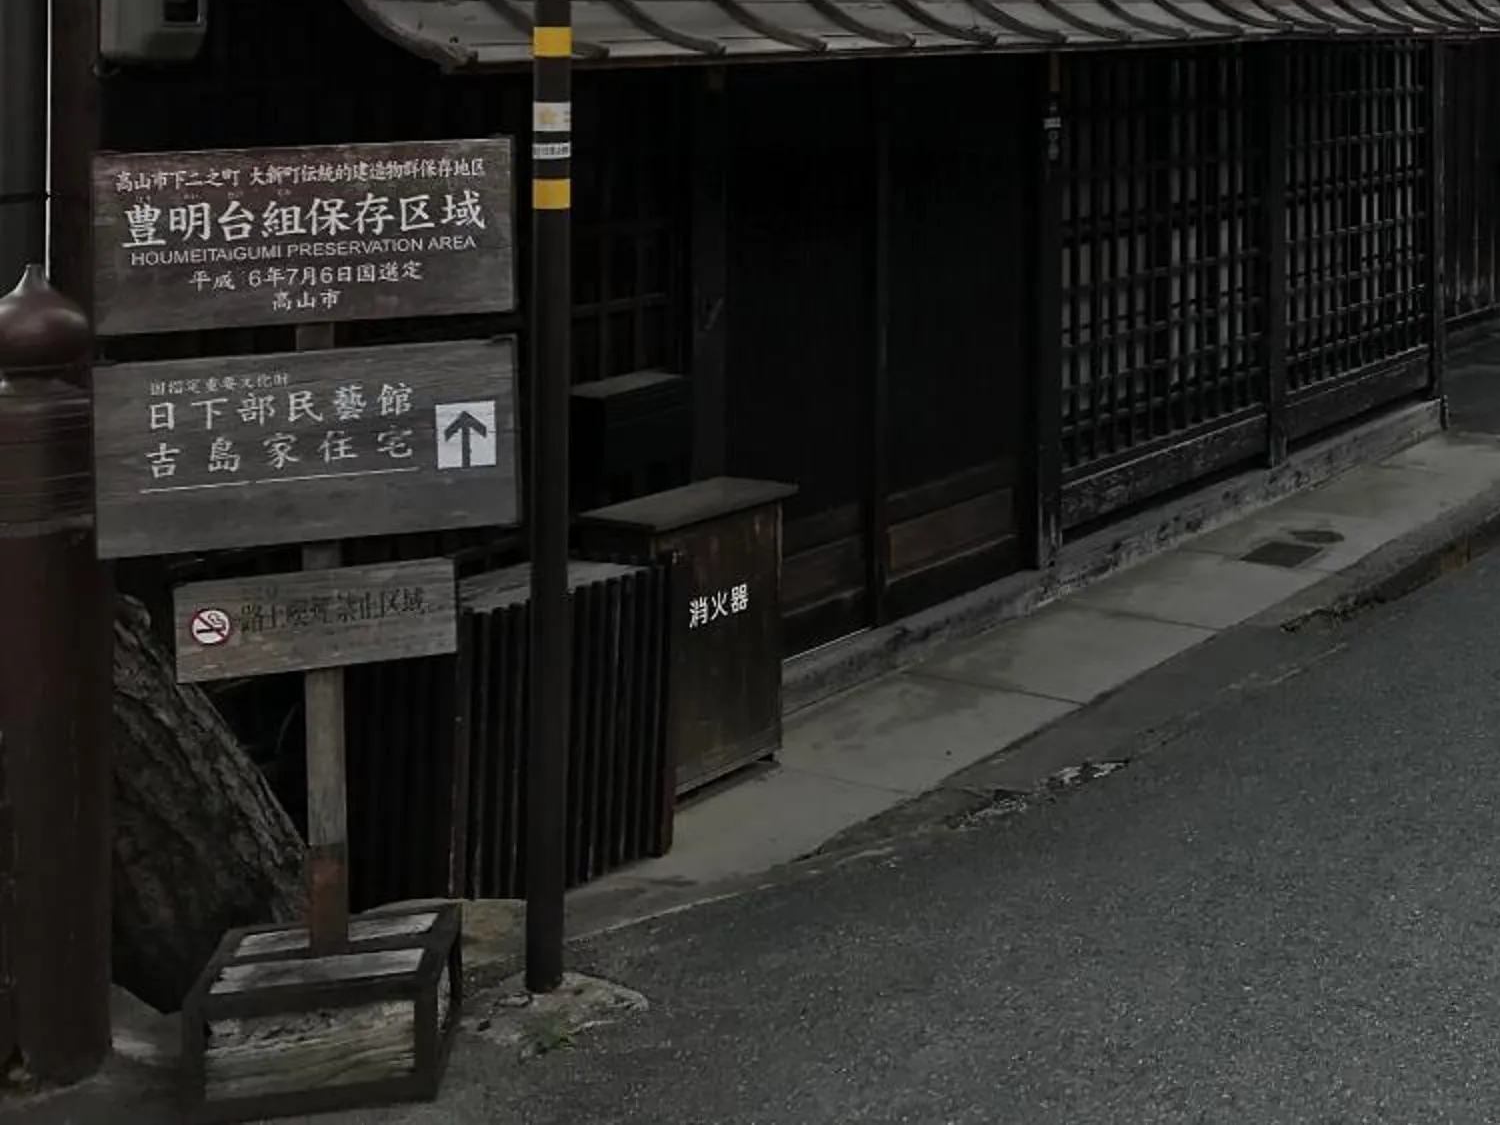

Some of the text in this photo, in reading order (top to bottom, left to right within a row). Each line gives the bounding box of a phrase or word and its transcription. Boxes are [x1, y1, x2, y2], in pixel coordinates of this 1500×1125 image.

[122, 188, 487, 249] 豊明台組保存区域
[131, 235, 477, 266] HOUMEITAIGUMI PRESERVATION AREA
[188, 270, 236, 292] 平成
[272, 288, 342, 311] 高山市
[149, 382, 415, 430] 日下部民藝館
[145, 425, 415, 479] 吉島家住宅
[689, 583, 749, 628] 消火器
